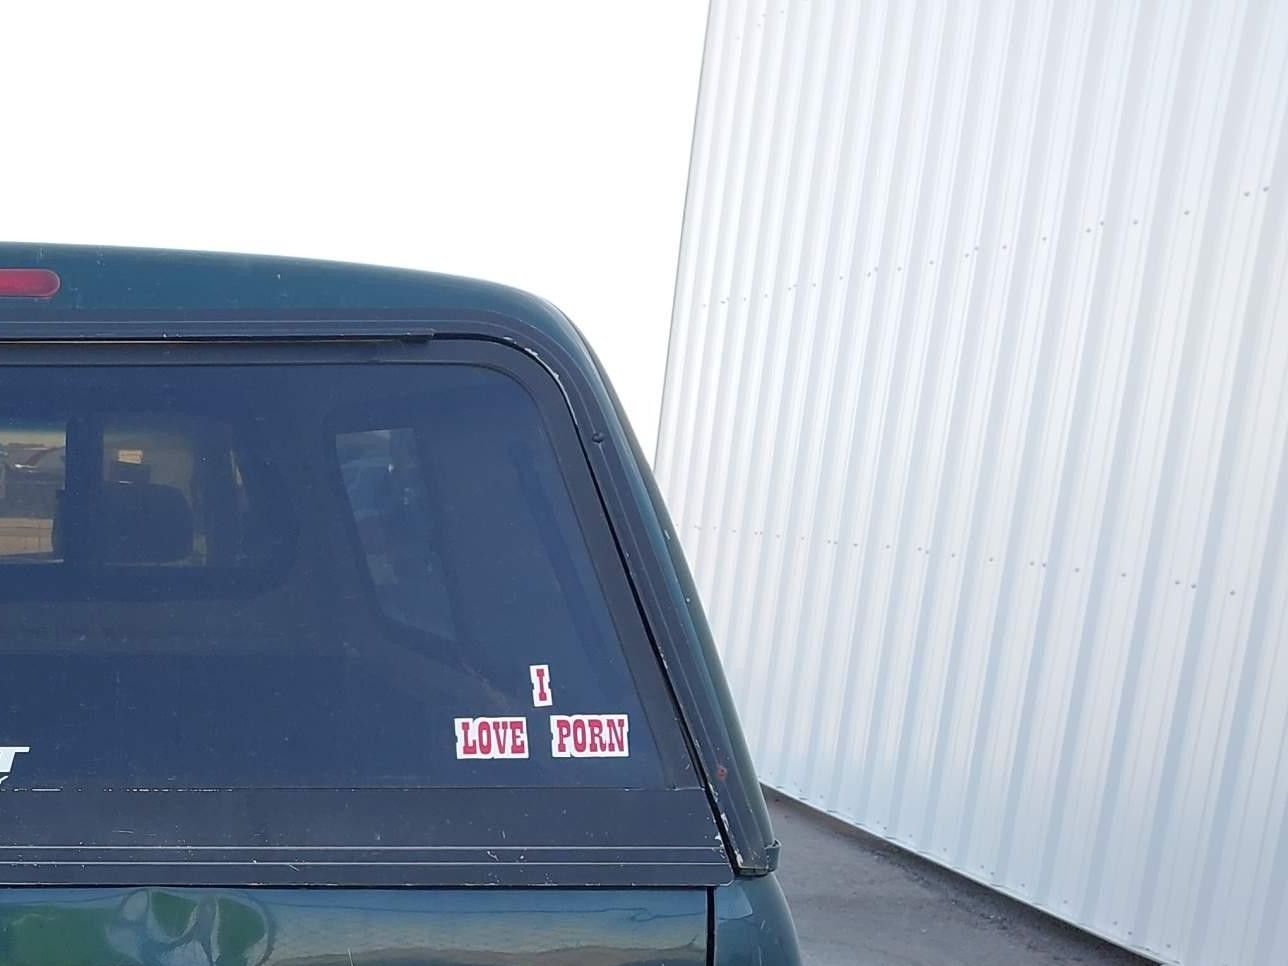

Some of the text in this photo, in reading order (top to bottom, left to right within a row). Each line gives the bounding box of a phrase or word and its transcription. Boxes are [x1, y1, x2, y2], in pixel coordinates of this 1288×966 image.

[534, 668, 548, 702] I
[461, 719, 625, 755] LOVE PORN
